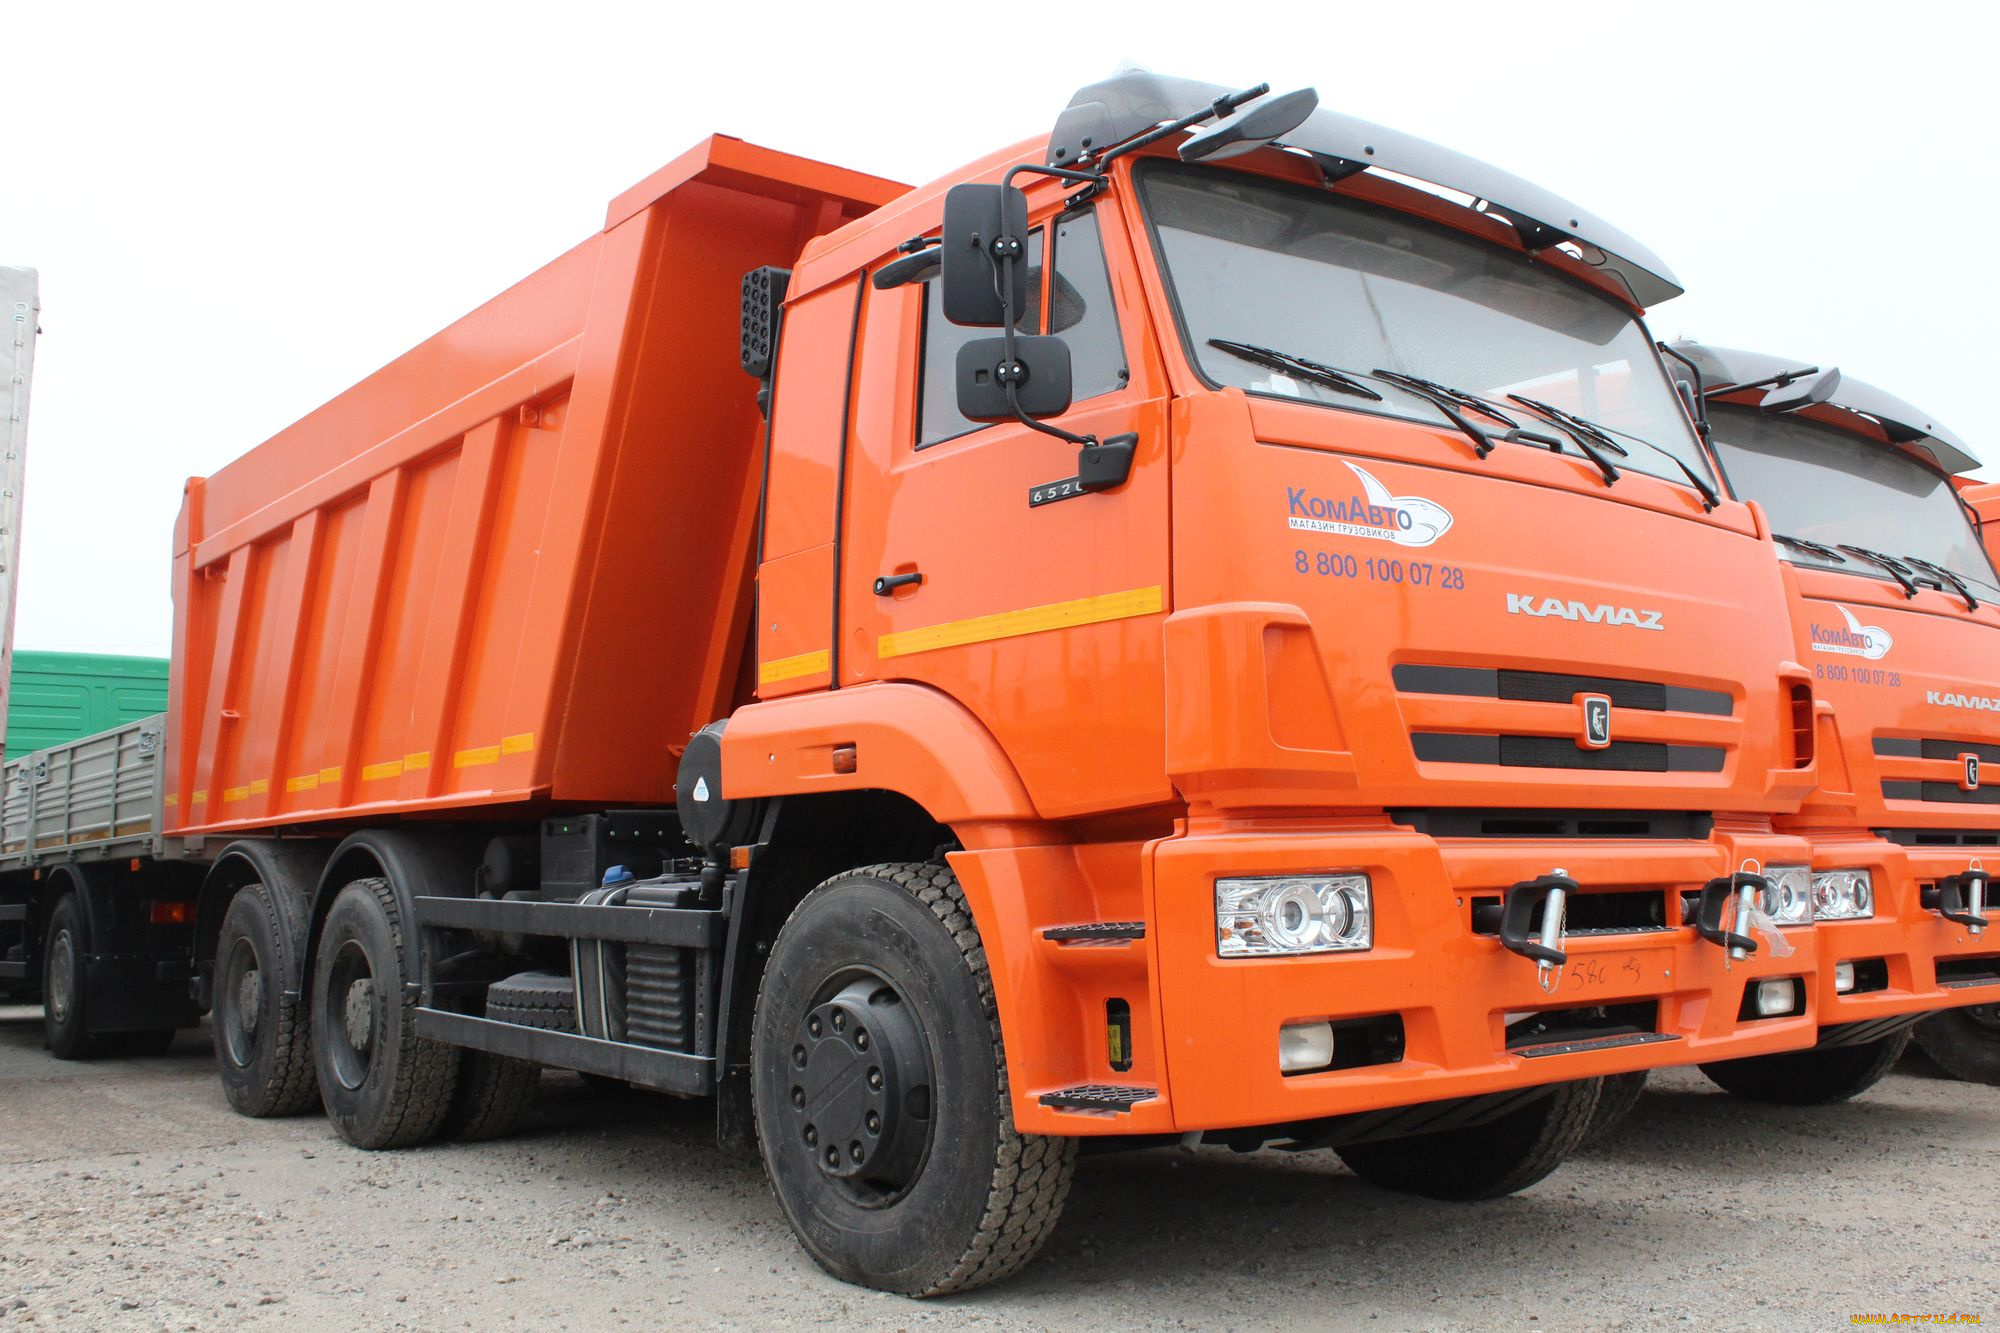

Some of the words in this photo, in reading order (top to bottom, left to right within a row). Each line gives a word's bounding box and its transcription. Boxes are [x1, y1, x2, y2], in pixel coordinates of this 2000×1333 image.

[1290, 519, 1335, 532] МАГАЗИН
[1338, 524, 1396, 540] ГРУЗОВИКОВ
[1295, 550, 1309, 574] 8
[1316, 552, 1357, 578] 800
[1365, 557, 1403, 583] 100
[1409, 562, 1432, 586] 07
[1440, 566, 1464, 591] 28
[1506, 592, 1664, 630] KAMAZ
[1816, 663, 1824, 679] 8
[1827, 664, 1847, 681] 800
[1851, 667, 1870, 684] 100
[1873, 670, 1884, 685] 07
[1888, 671, 1901, 688] 28
